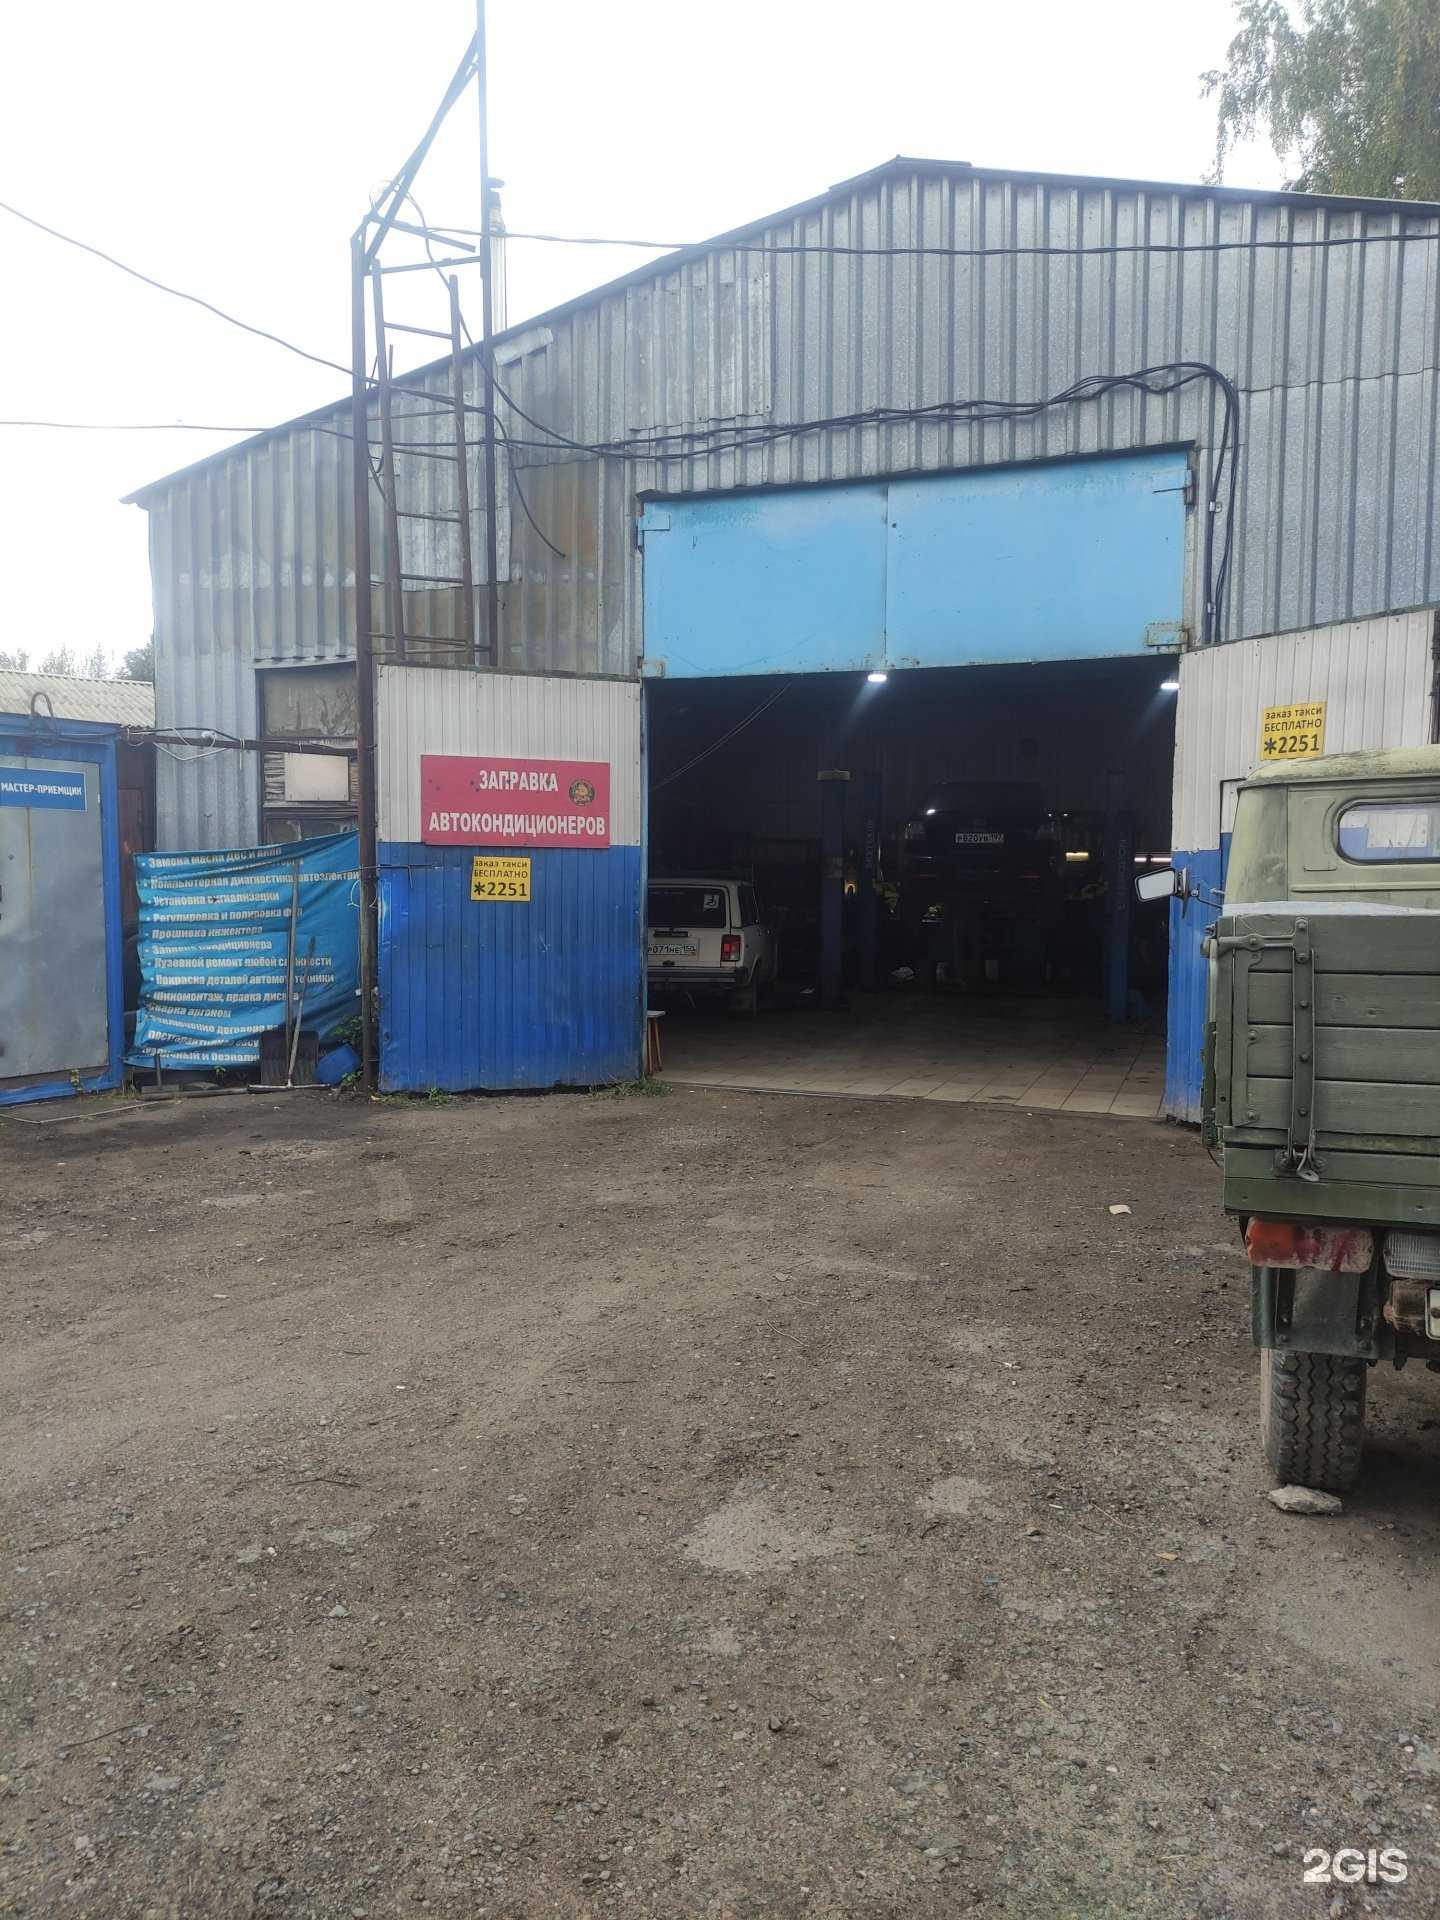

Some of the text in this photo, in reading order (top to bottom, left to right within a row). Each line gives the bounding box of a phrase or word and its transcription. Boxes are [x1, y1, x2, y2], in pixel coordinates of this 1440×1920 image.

[1265, 707, 1322, 719] заказ такси
[1264, 718, 1322, 732] БЕСПЛАТНО
[479, 770, 558, 792] ЗАПРАВКА
[0, 782, 82, 796] МАСТЕР-ПРИЕМЩИК
[429, 812, 605, 837] АВТОКОНДИЦИОНЕРОВ
[298, 871, 360, 882] автоэлектри
[474, 869, 528, 878] БЕСПЛАТНО
[263, 991, 299, 1002] дискв
[211, 1053, 261, 1062] безнали
